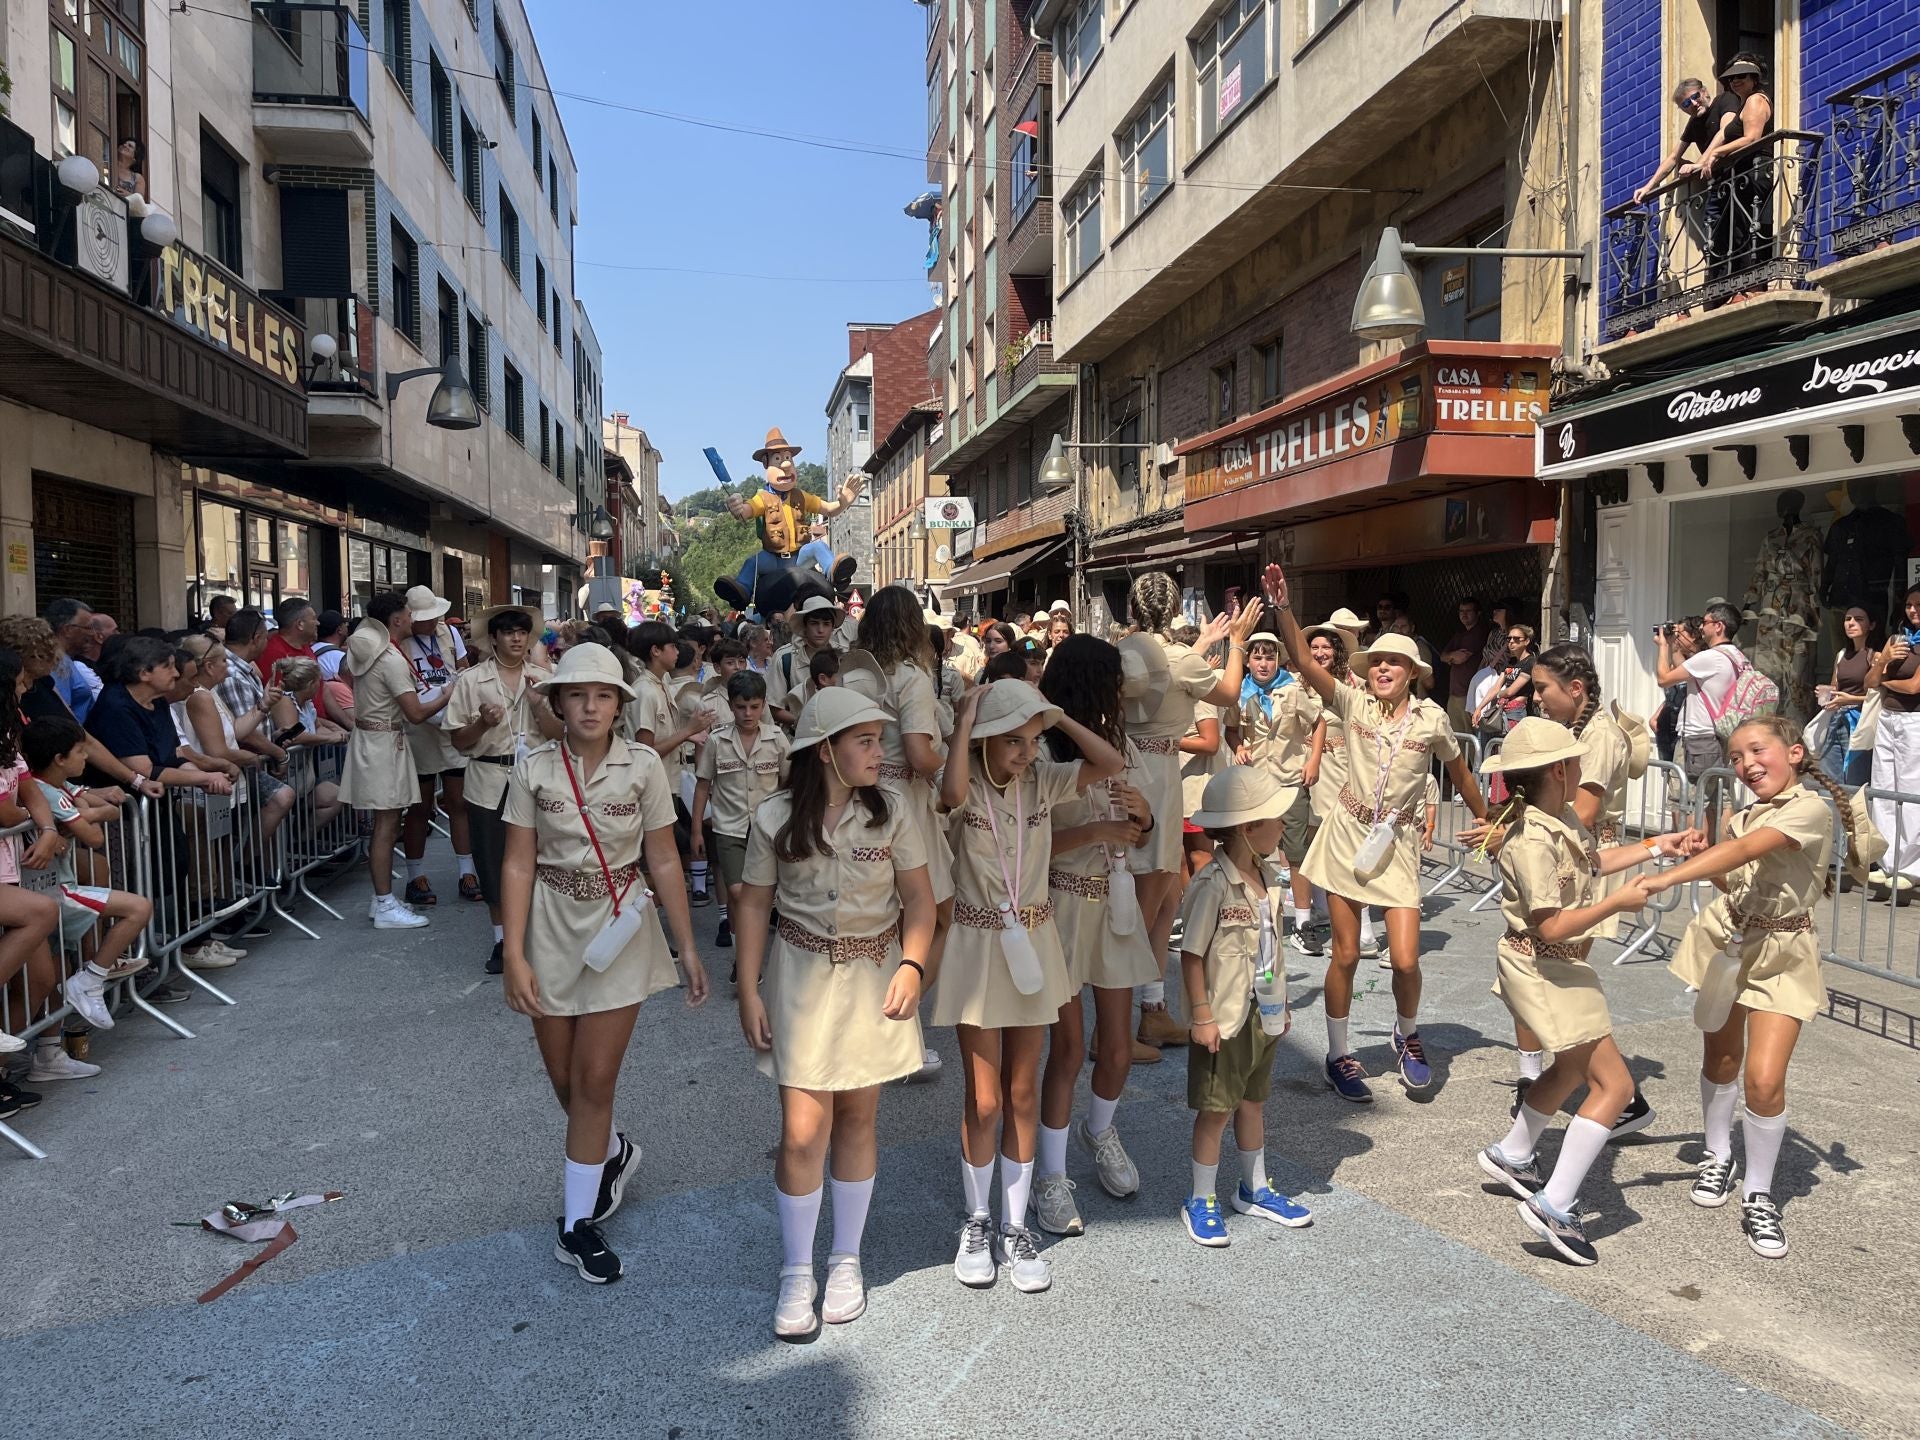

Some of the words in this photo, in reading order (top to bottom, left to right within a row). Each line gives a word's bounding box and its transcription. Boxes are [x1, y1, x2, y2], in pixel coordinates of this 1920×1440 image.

[160, 246, 298, 384] TRELLES
[1437, 367, 1481, 386] CASA
[1437, 399, 1543, 422] TRELLES
[1224, 441, 1252, 473] CASA
[1256, 396, 1370, 477] TRELLES
[929, 520, 972, 528] BUNKAI
